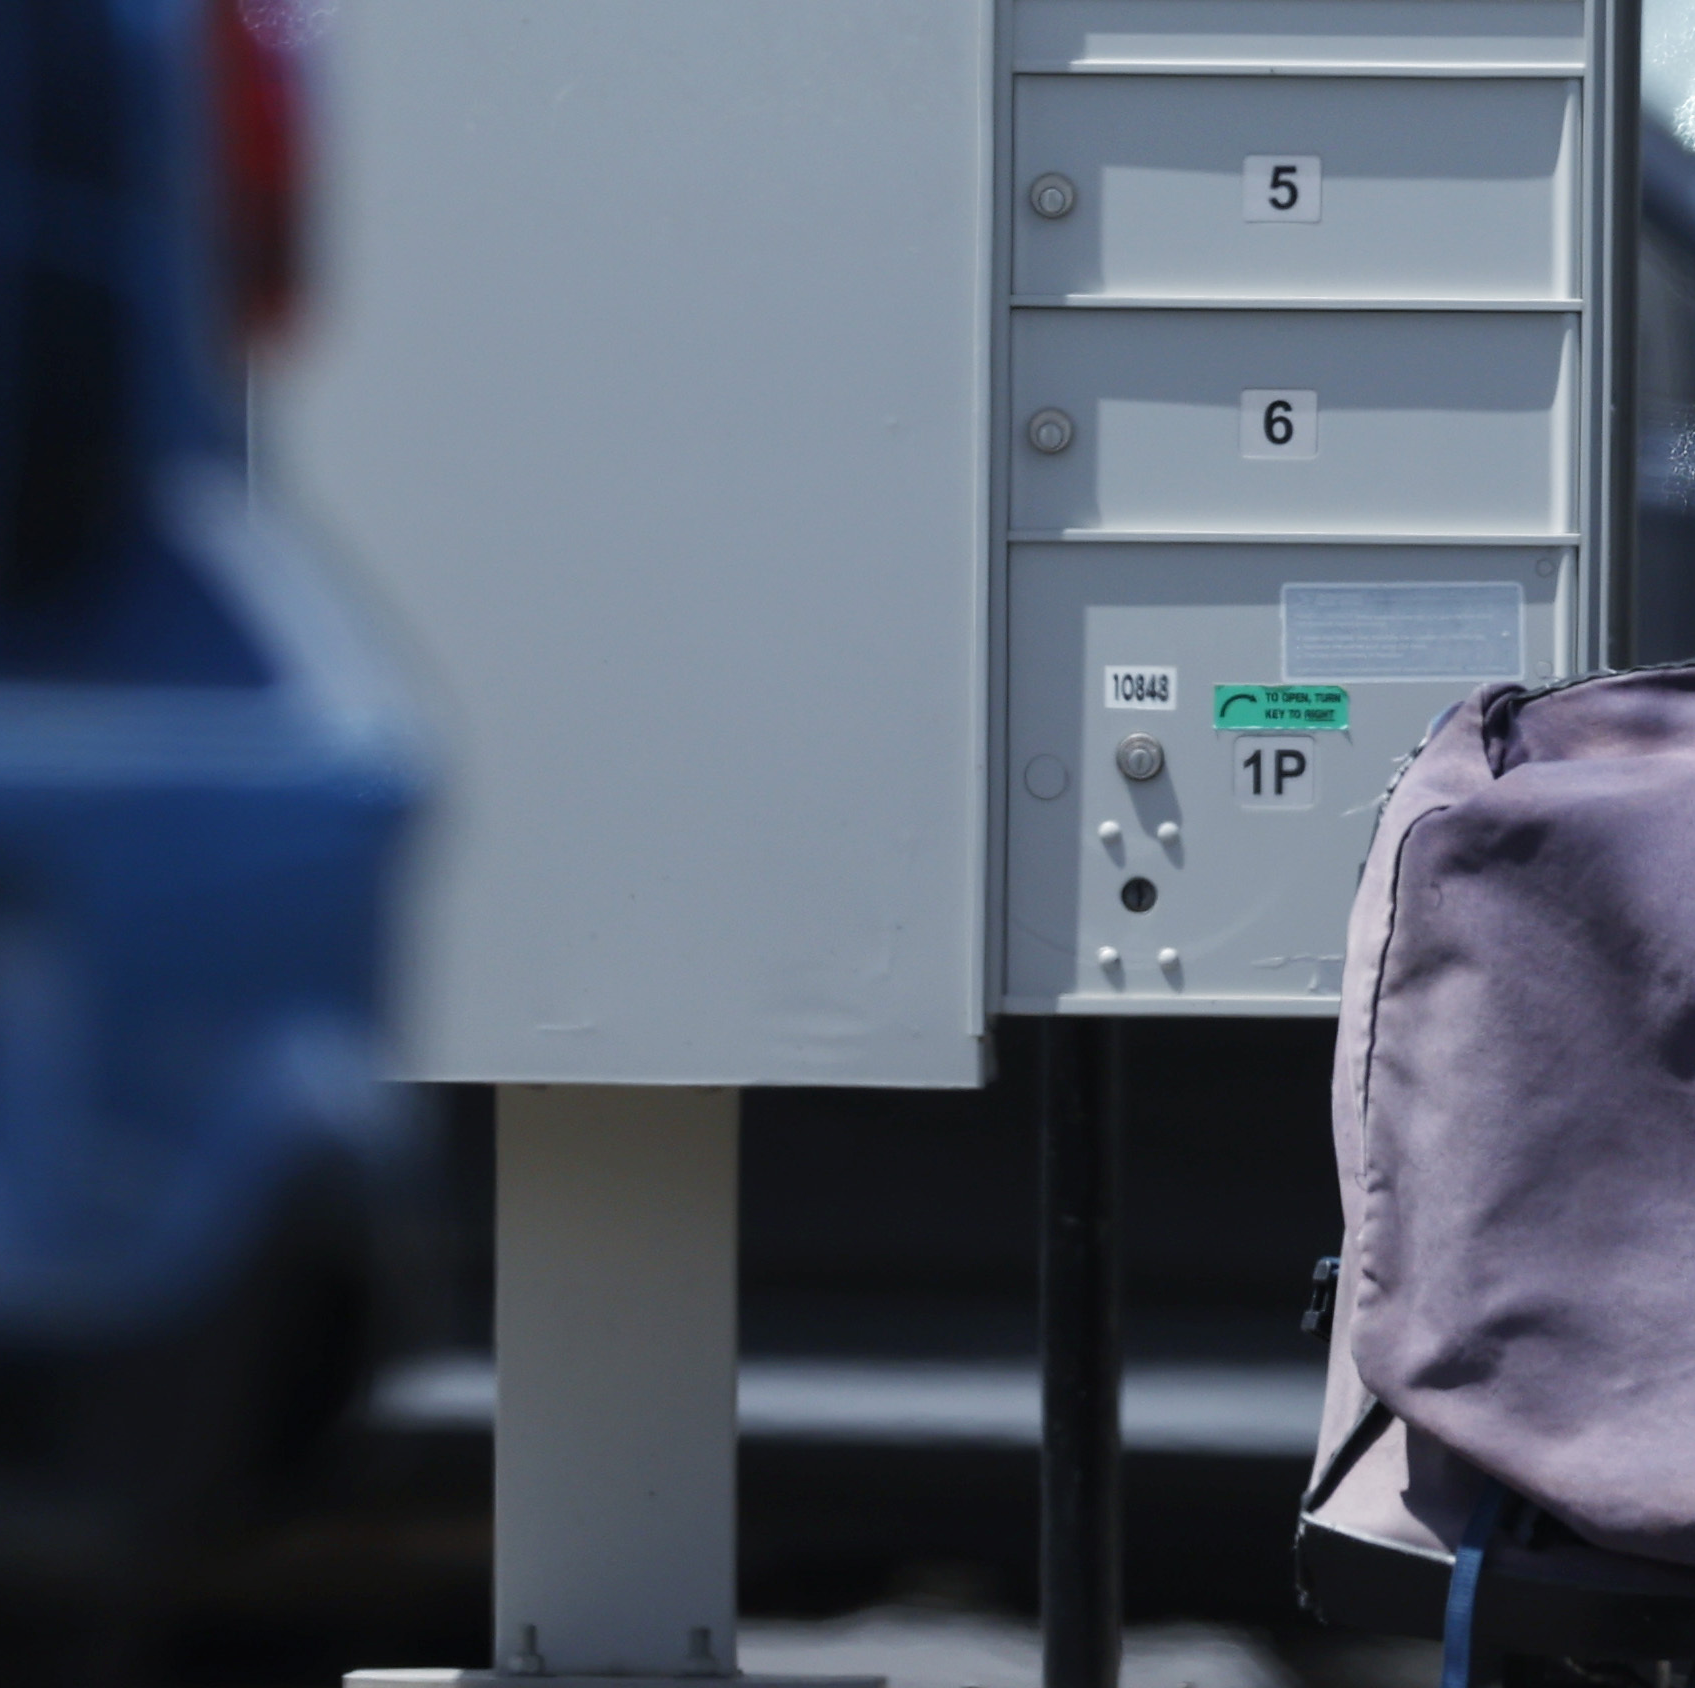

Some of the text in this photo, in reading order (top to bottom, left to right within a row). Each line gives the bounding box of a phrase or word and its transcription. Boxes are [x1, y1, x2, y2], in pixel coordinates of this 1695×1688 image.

[1267, 165, 1300, 212] 5
[1262, 399, 1295, 446] 6
[1265, 692, 1279, 703] TO
[1314, 692, 1342, 703] TURN
[1265, 708, 1336, 721] KEY TO RIGHT
[1242, 749, 1308, 796] 1P
